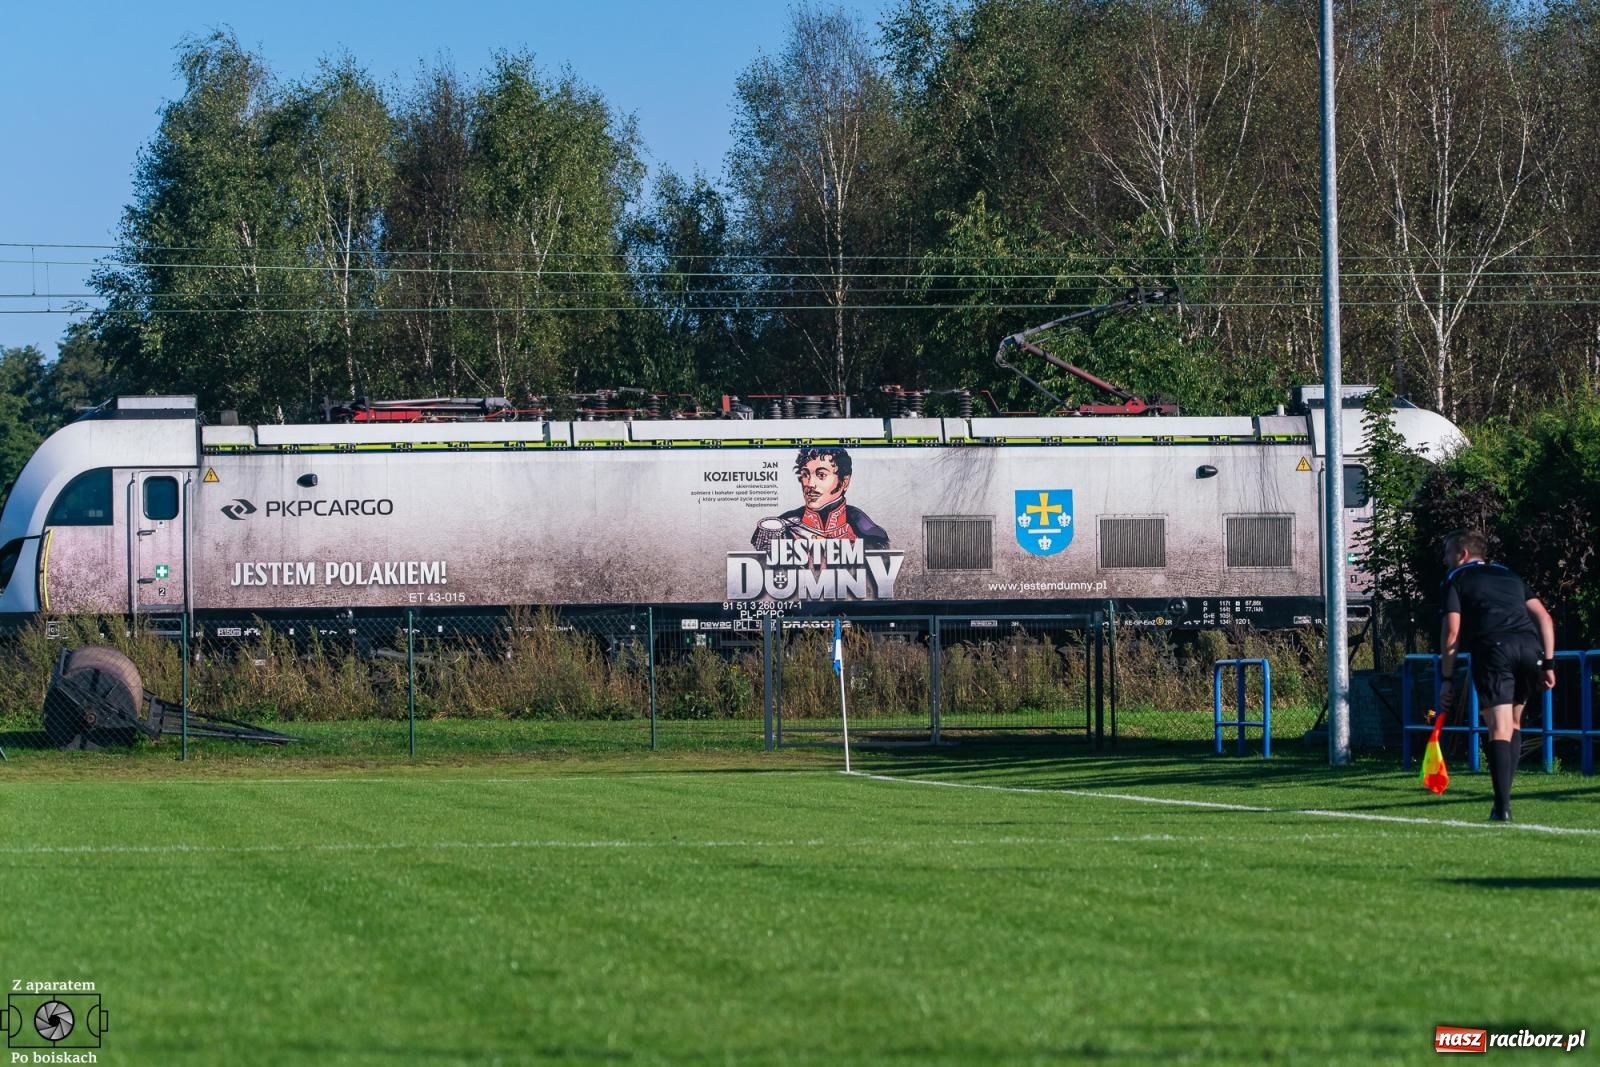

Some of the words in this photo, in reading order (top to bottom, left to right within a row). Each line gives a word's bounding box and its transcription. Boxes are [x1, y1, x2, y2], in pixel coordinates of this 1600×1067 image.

[762, 461, 779, 469] JAN
[703, 471, 778, 482] KOZIETULSKI
[766, 538, 864, 565] JESTEM
[231, 562, 315, 586] JESTEM
[325, 561, 448, 585] POLAKIEM!
[727, 556, 905, 600] DUMNY
[988, 580, 1108, 592] www.jestemdumny.pl
[409, 593, 423, 603] ET
[427, 593, 465, 602] 43-015
[723, 601, 733, 610] 91
[736, 601, 747, 610] 51
[750, 601, 756, 610] 3
[758, 601, 775, 610] 260
[777, 601, 802, 610] 017-1
[736, 621, 747, 630] PL
